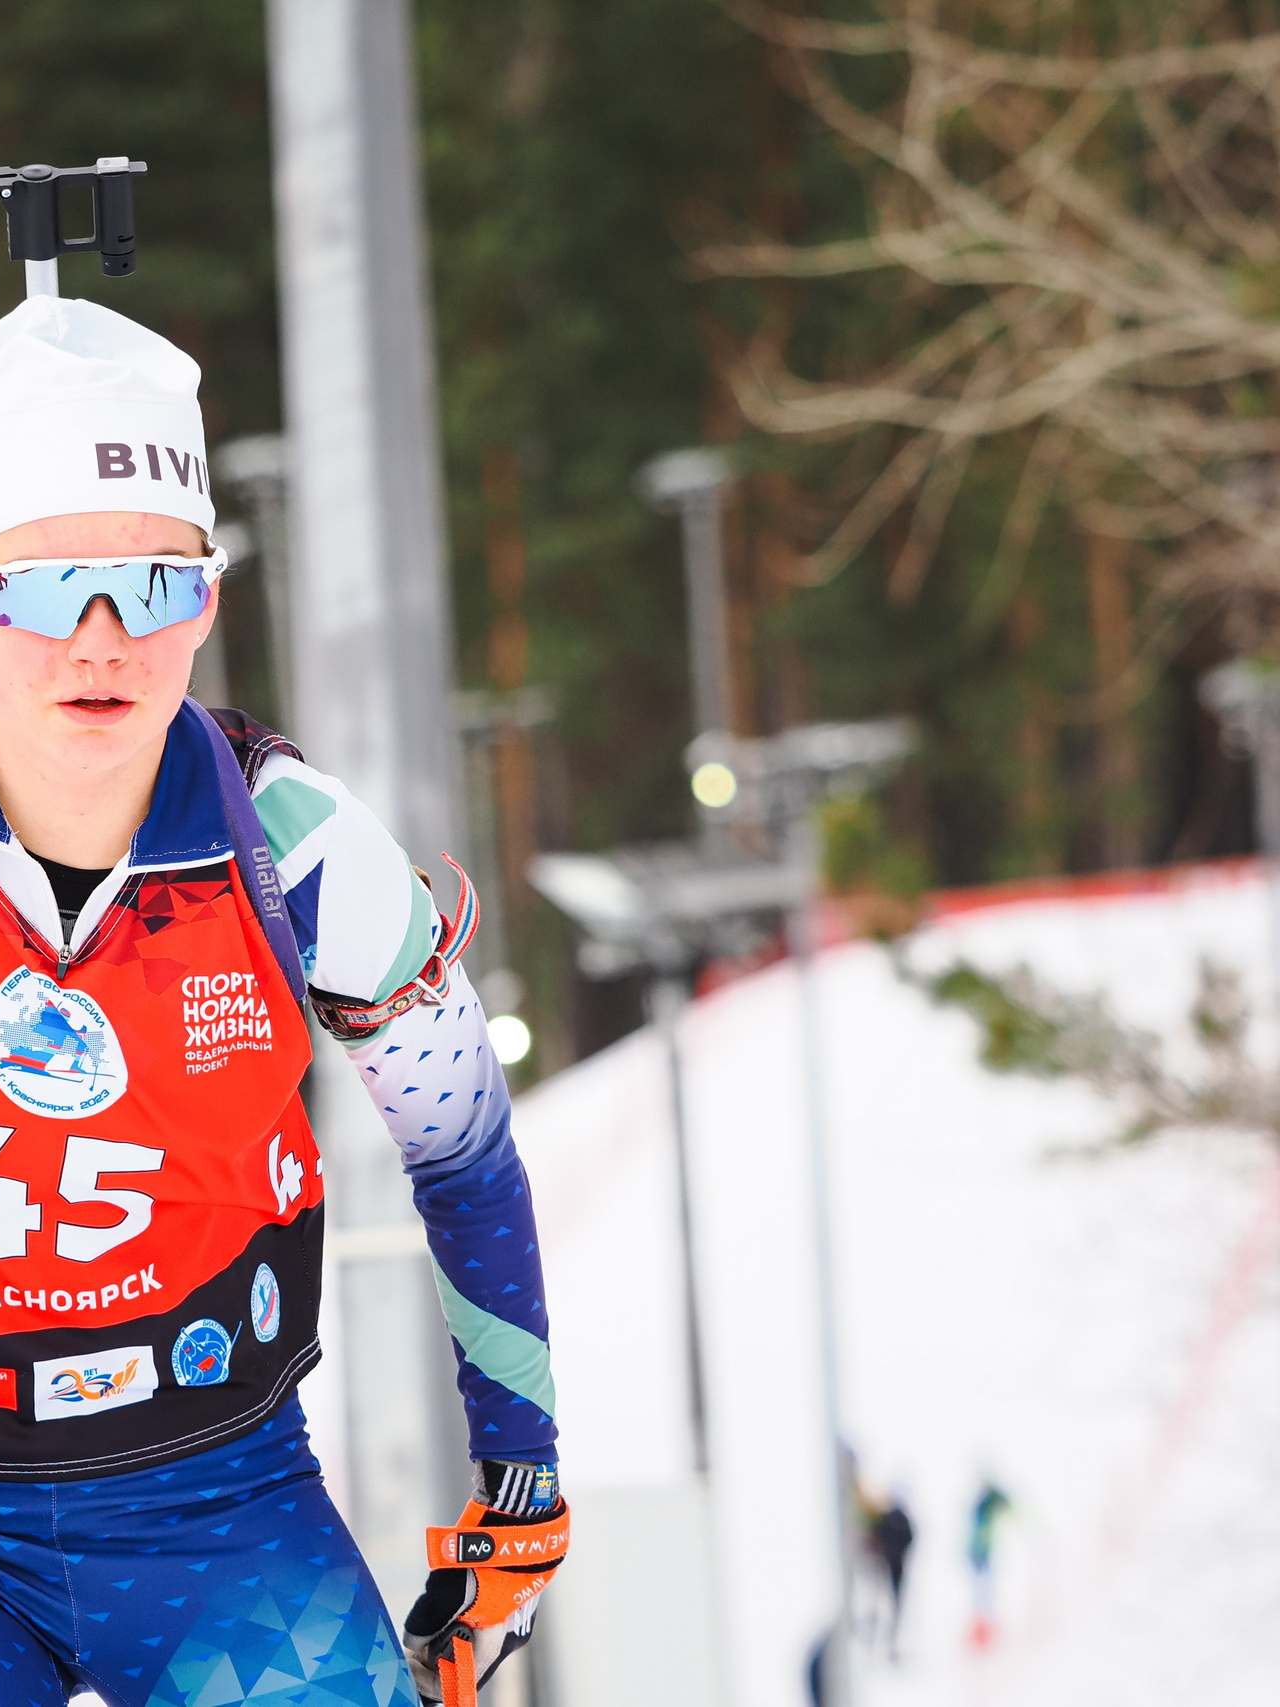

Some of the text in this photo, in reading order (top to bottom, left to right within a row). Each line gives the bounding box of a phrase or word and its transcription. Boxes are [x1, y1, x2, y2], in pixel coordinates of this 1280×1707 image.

[95, 443, 211, 498] BIVI
[183, 995, 269, 1023] НОРМА
[184, 1016, 272, 1047] ЖИЗНИ
[184, 1040, 272, 1061] ФЕДЕРАЛЬНЫЙ
[186, 1056, 229, 1075] ПРОЕКТ
[7, 1080, 74, 1112] Красноярск
[80, 1088, 110, 1110] 2023
[83, 1367, 98, 1376] ЛЕТ
[448, 1538, 456, 1558] LEFT
[468, 1540, 491, 1556] O/W
[513, 1576, 545, 1604] AVWC
